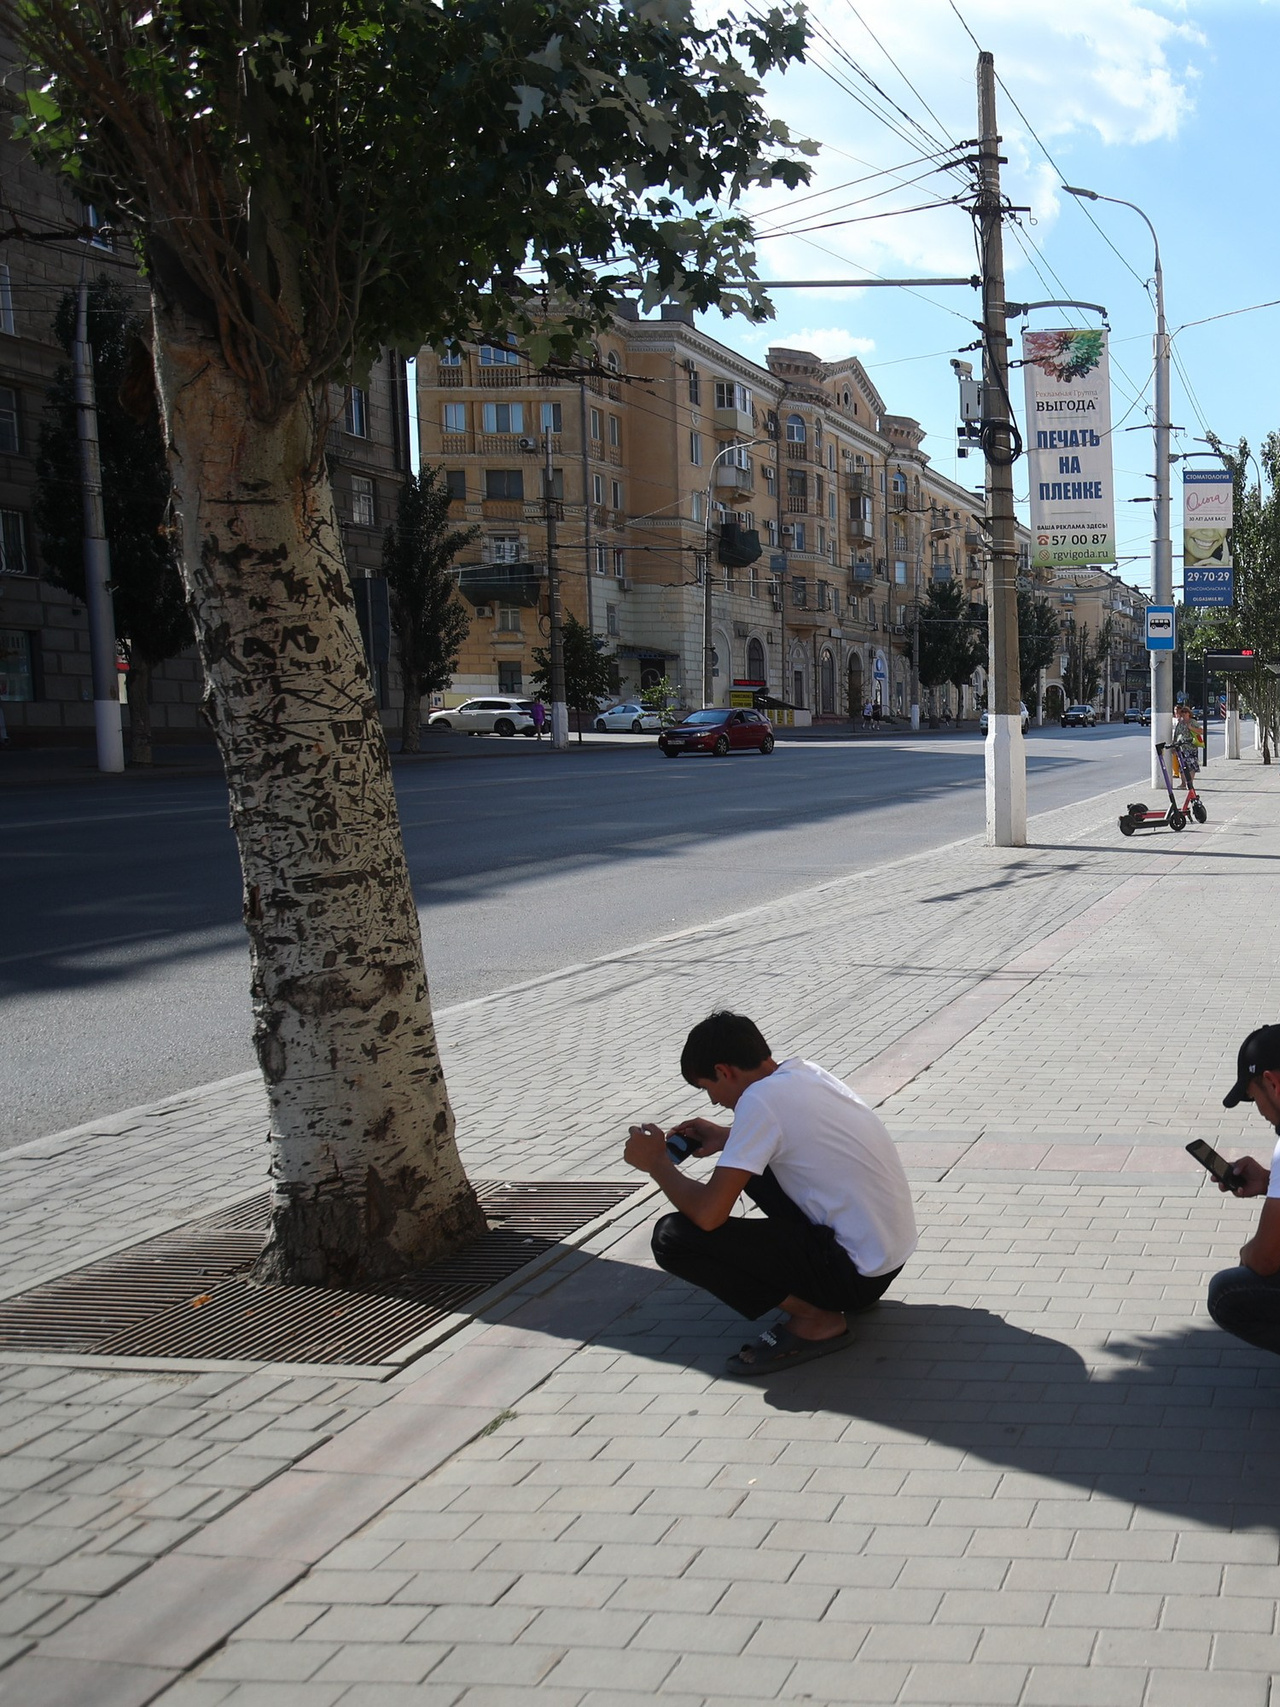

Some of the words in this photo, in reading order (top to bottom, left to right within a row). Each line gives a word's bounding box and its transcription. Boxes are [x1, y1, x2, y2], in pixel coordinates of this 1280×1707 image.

[1036, 400, 1096, 412] ВЫГОДА
[1037, 429, 1100, 449] ПЕЧАТЬ
[1059, 456, 1081, 474] НА
[1039, 481, 1103, 500] ПЛЕНКЕ
[1052, 535, 1067, 546] 57
[1071, 534, 1088, 545] 00
[1091, 534, 1107, 545] 87
[1053, 549, 1109, 561] rgvigoda.ru
